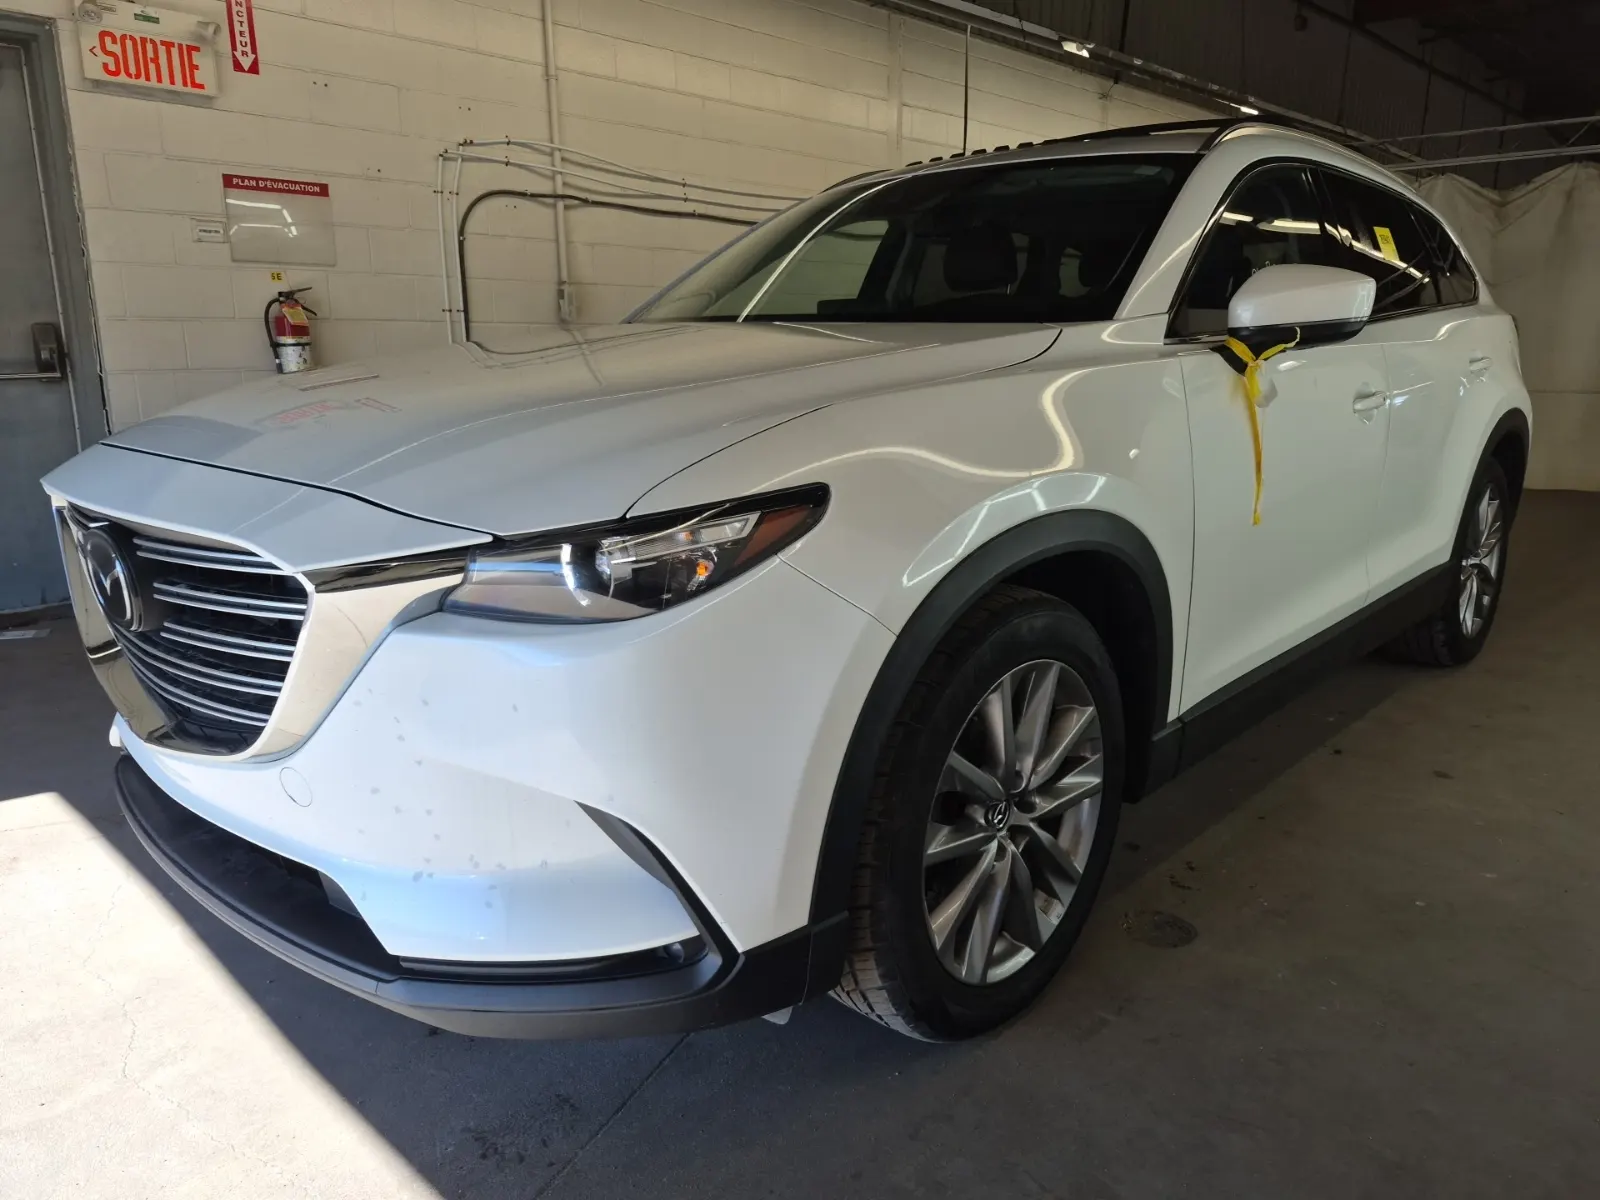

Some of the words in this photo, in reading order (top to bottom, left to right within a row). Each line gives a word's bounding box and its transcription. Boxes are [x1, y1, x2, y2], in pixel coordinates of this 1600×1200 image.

[98, 30, 205, 90] SORTIE
[232, 178, 257, 187] PLAN
[259, 179, 320, 193] D'ÉVACUATION
